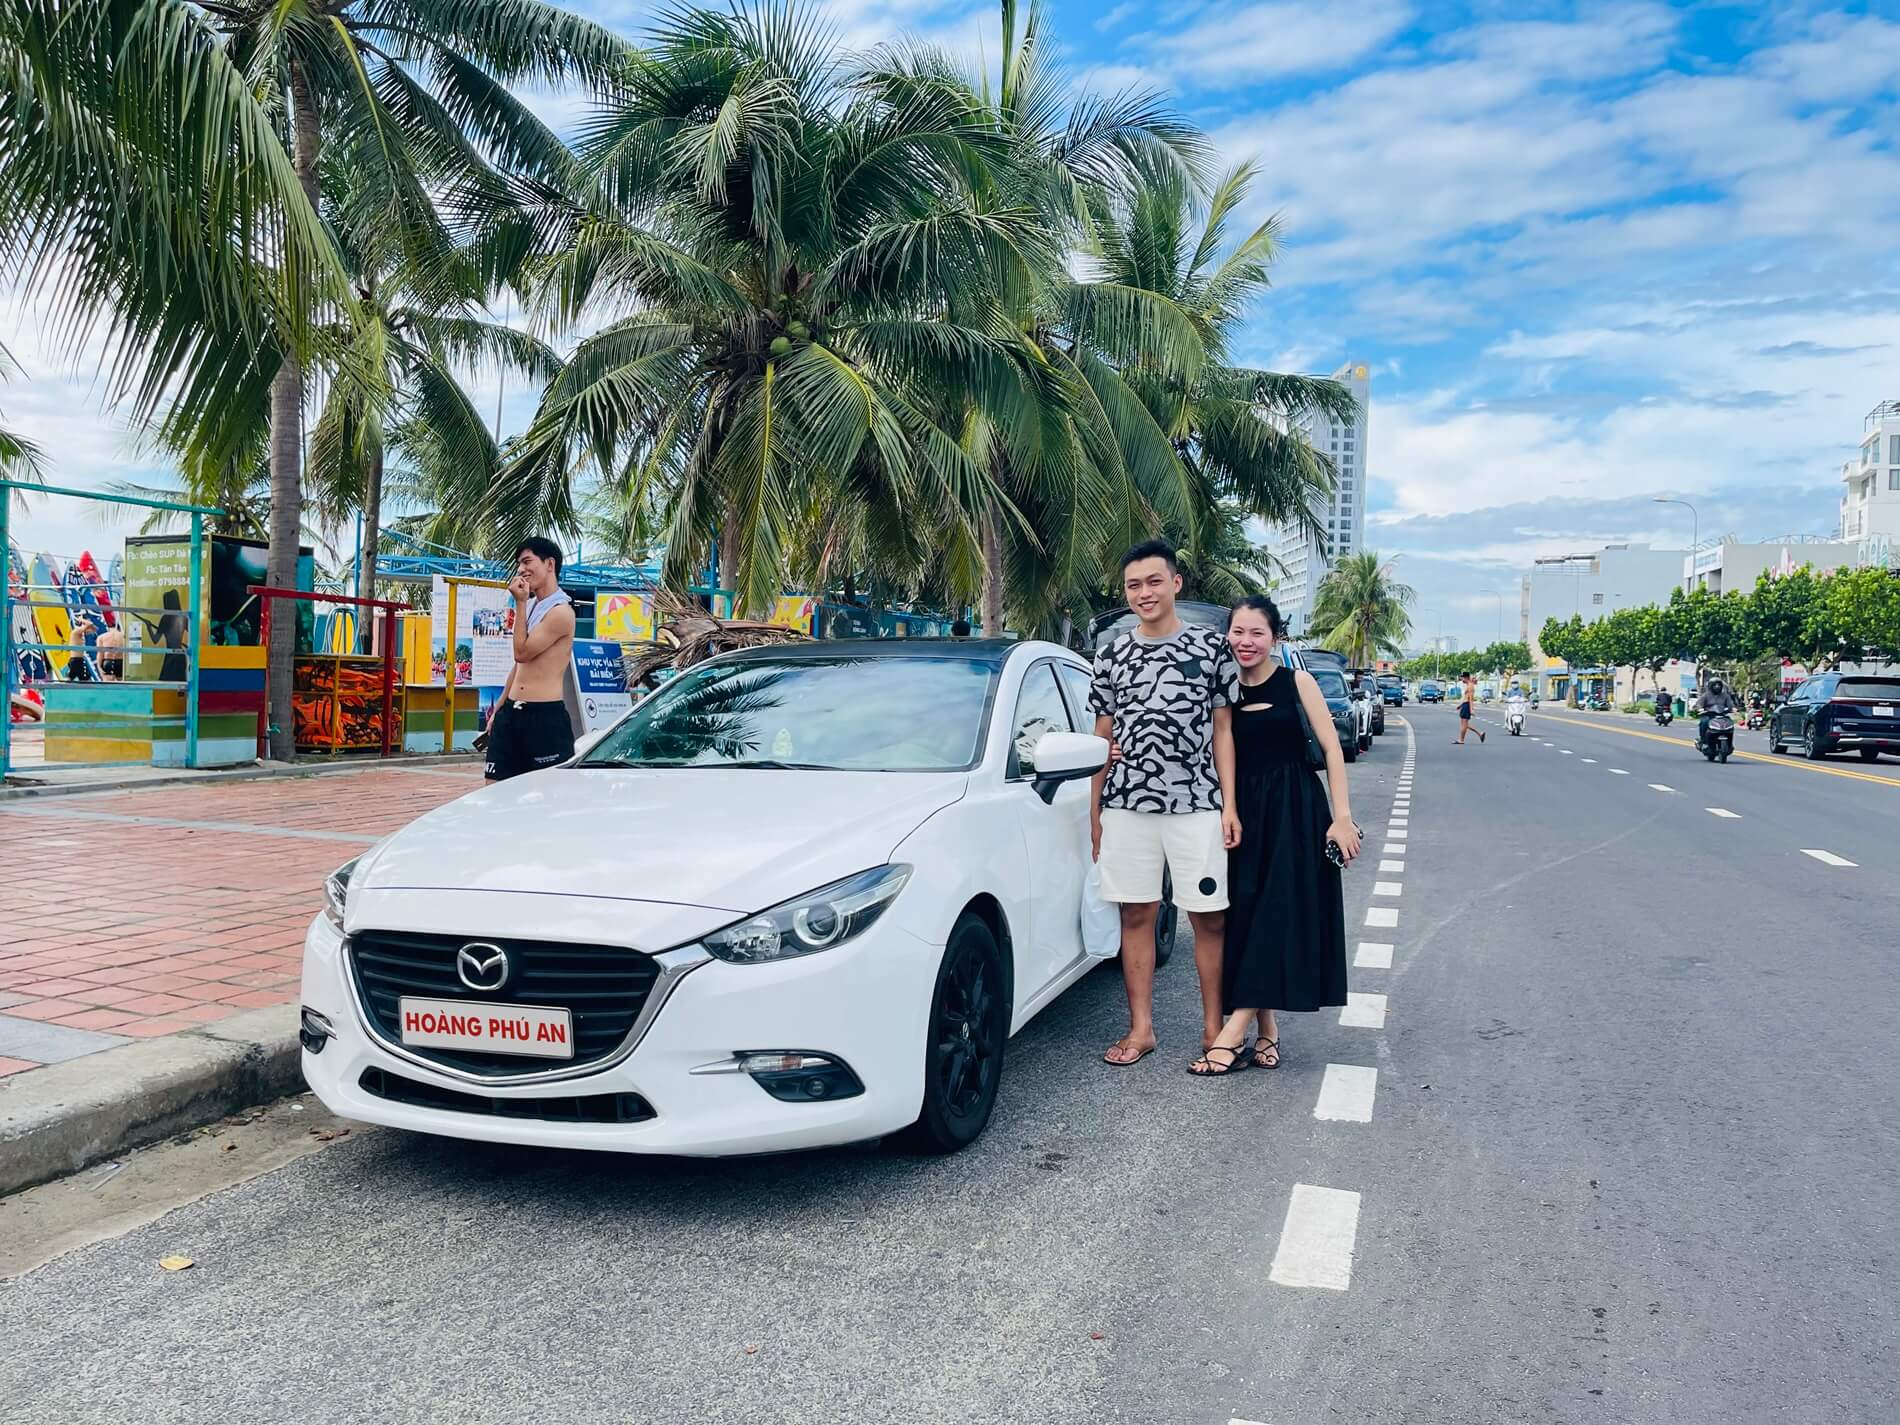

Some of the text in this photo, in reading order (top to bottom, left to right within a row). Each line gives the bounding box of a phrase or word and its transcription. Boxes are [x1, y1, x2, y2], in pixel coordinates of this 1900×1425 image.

[159, 549, 176, 559] SUP
[405, 1009, 566, 1043] HOÀNG PHÚ AN
